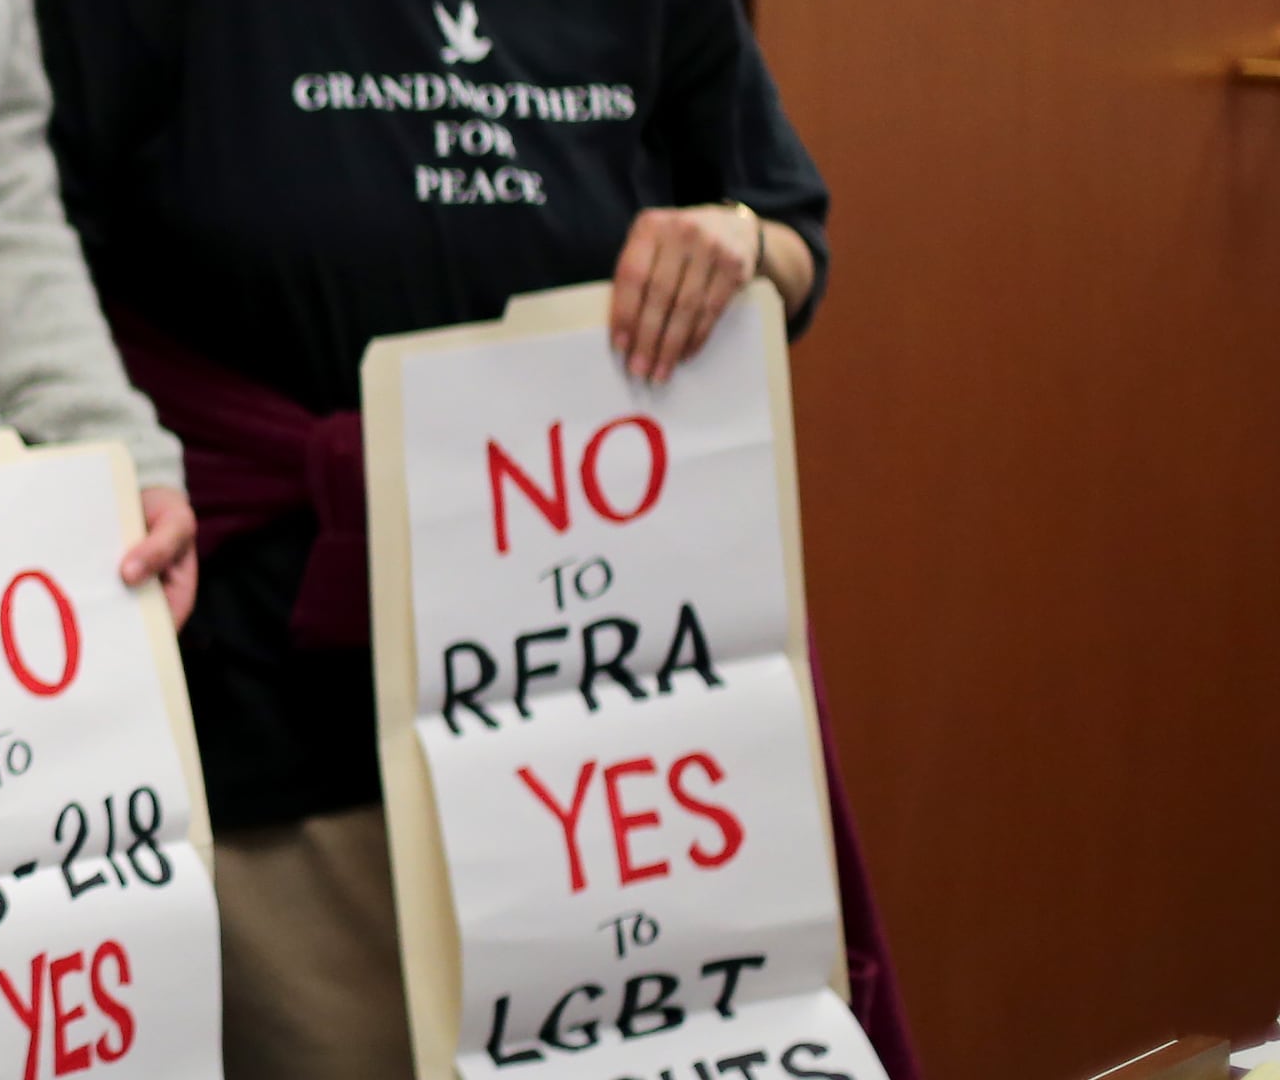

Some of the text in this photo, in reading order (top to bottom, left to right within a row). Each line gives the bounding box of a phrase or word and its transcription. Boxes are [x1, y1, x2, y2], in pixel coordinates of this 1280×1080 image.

[434, 119, 518, 160] FOR
[414, 164, 548, 206] PEACE
[486, 413, 669, 557] NO
[540, 556, 613, 610] TO
[442, 600, 725, 736] RFRA
[516, 749, 745, 895] YES
[597, 911, 660, 959] TO
[485, 955, 766, 1067] LGBT
